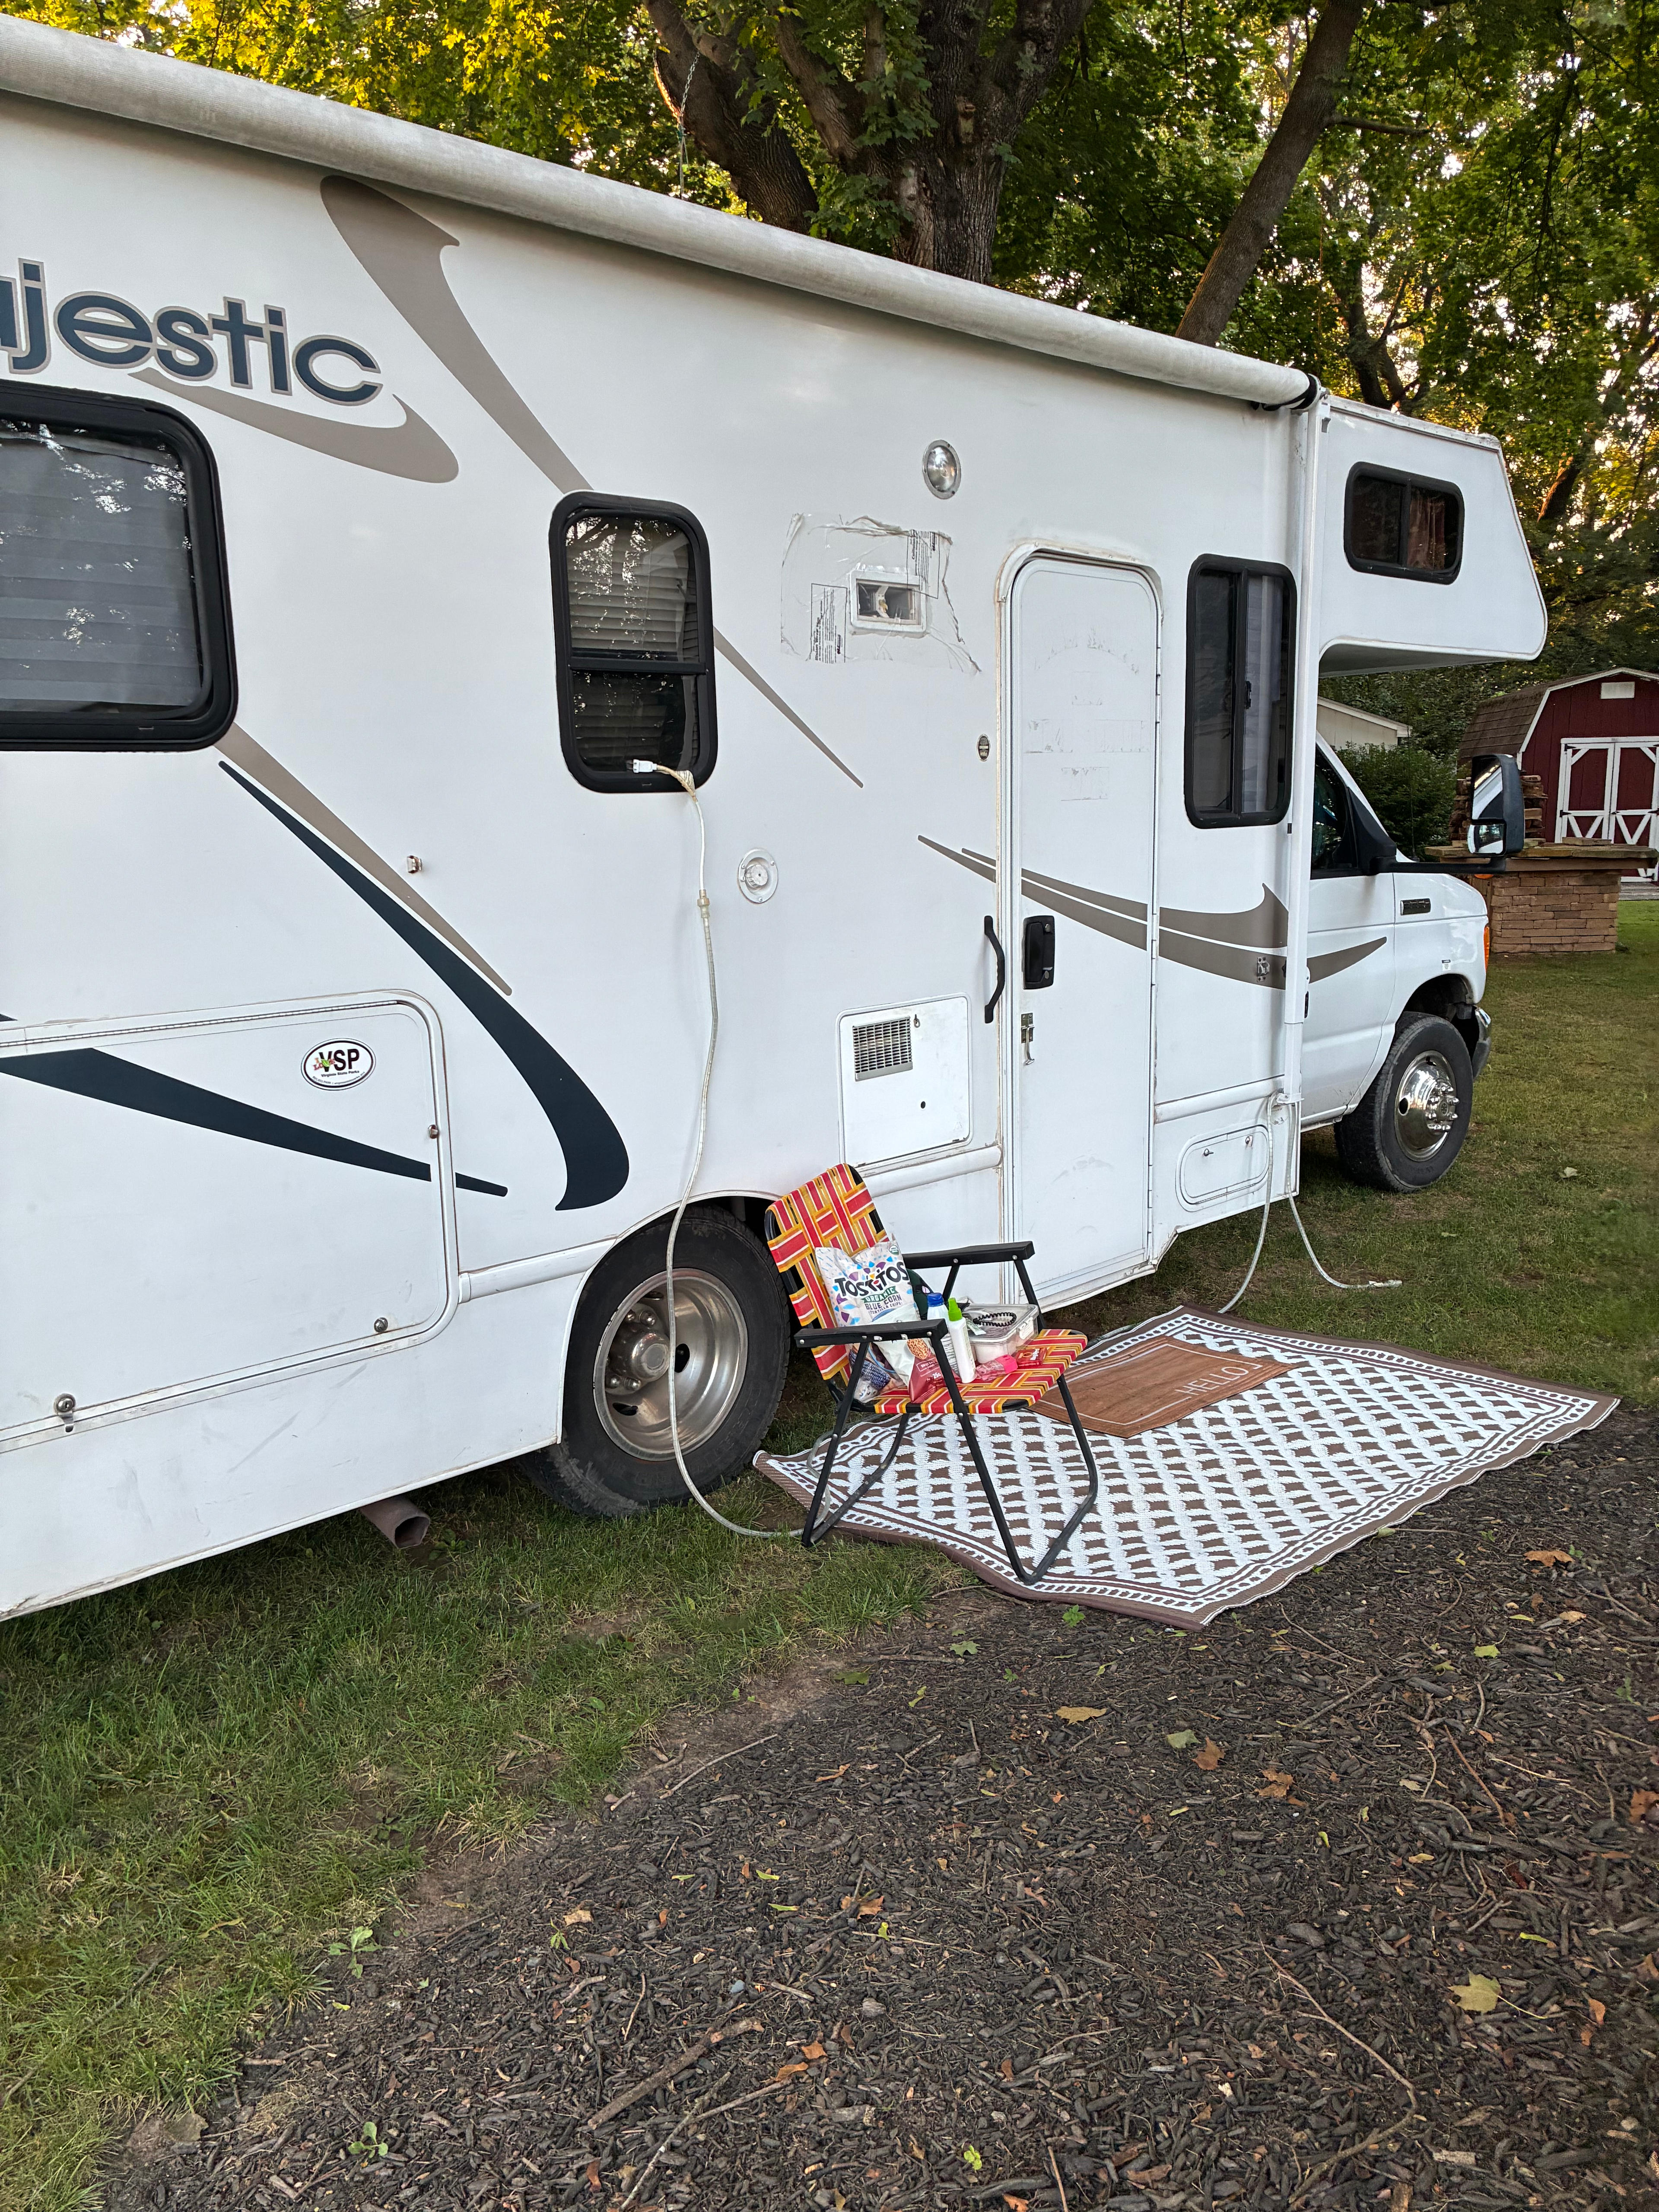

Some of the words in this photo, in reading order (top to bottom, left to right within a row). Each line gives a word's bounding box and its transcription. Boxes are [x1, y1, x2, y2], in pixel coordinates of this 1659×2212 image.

[0, 258, 383, 407] jestic
[313, 1058, 335, 1071] LOE
[318, 1049, 359, 1072] VSP
[865, 1287, 895, 1302] ORGANIC
[884, 1294, 902, 1305] CORN
[869, 1305, 889, 1314] TORTILLA
[1174, 1367, 1249, 1395] HELLO
